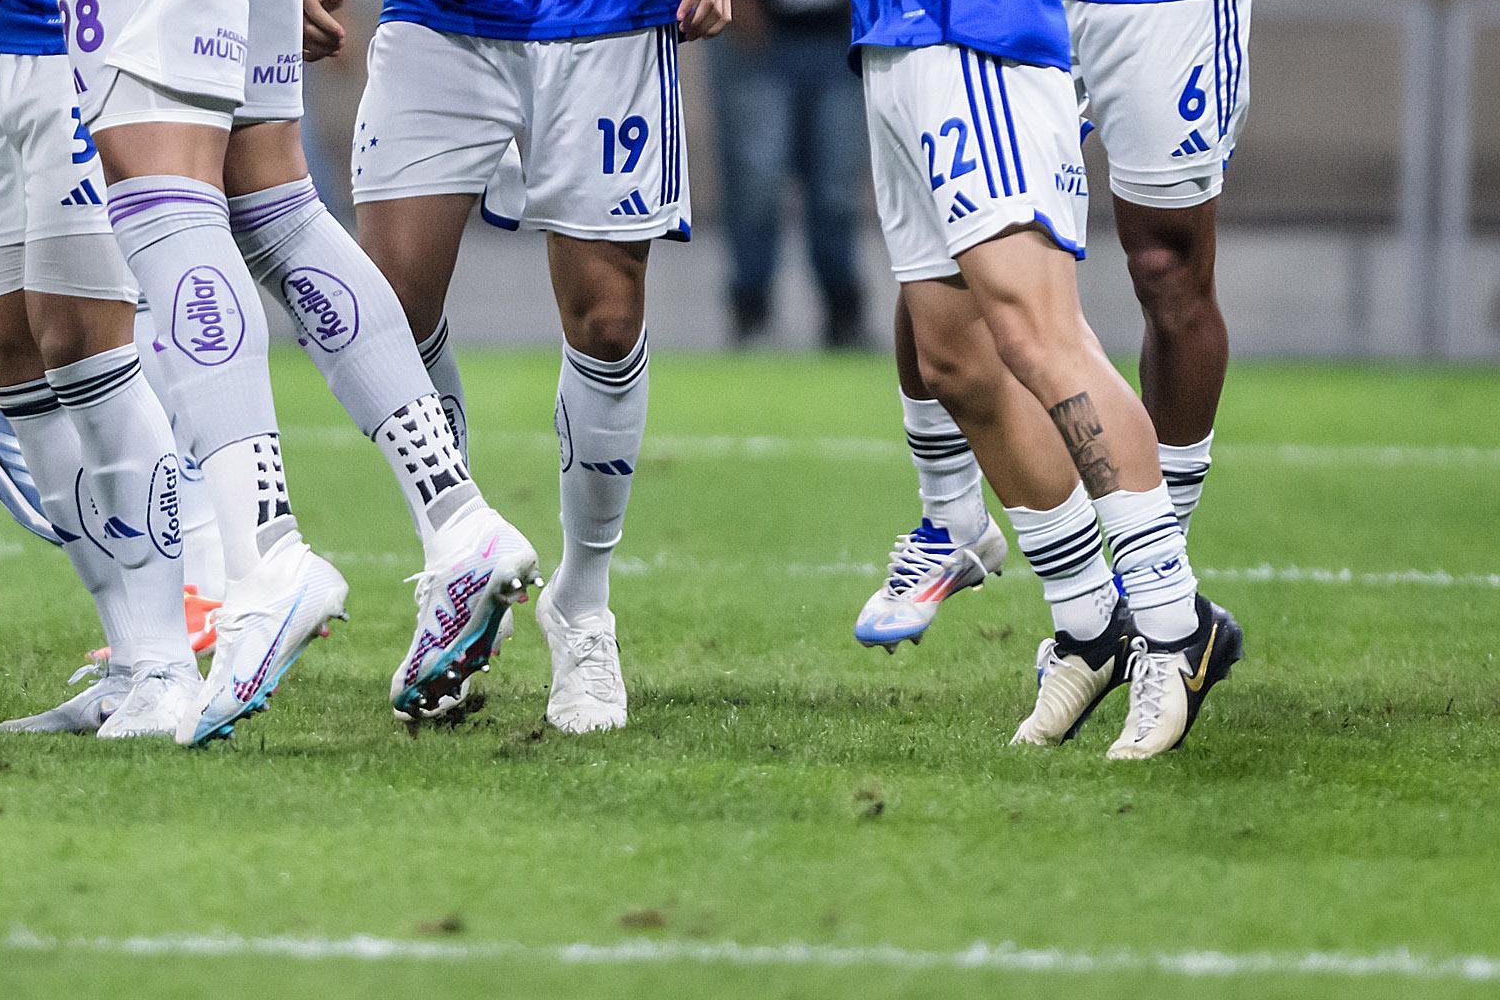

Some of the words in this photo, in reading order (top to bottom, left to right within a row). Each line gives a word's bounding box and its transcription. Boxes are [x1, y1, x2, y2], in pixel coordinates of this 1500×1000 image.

[1178, 63, 1207, 122] 6
[597, 114, 650, 175] 19
[920, 116, 977, 192] 22
[186, 275, 229, 352] Kodilar
[288, 276, 349, 341] Kodilar
[160, 465, 182, 547] Kodilar
